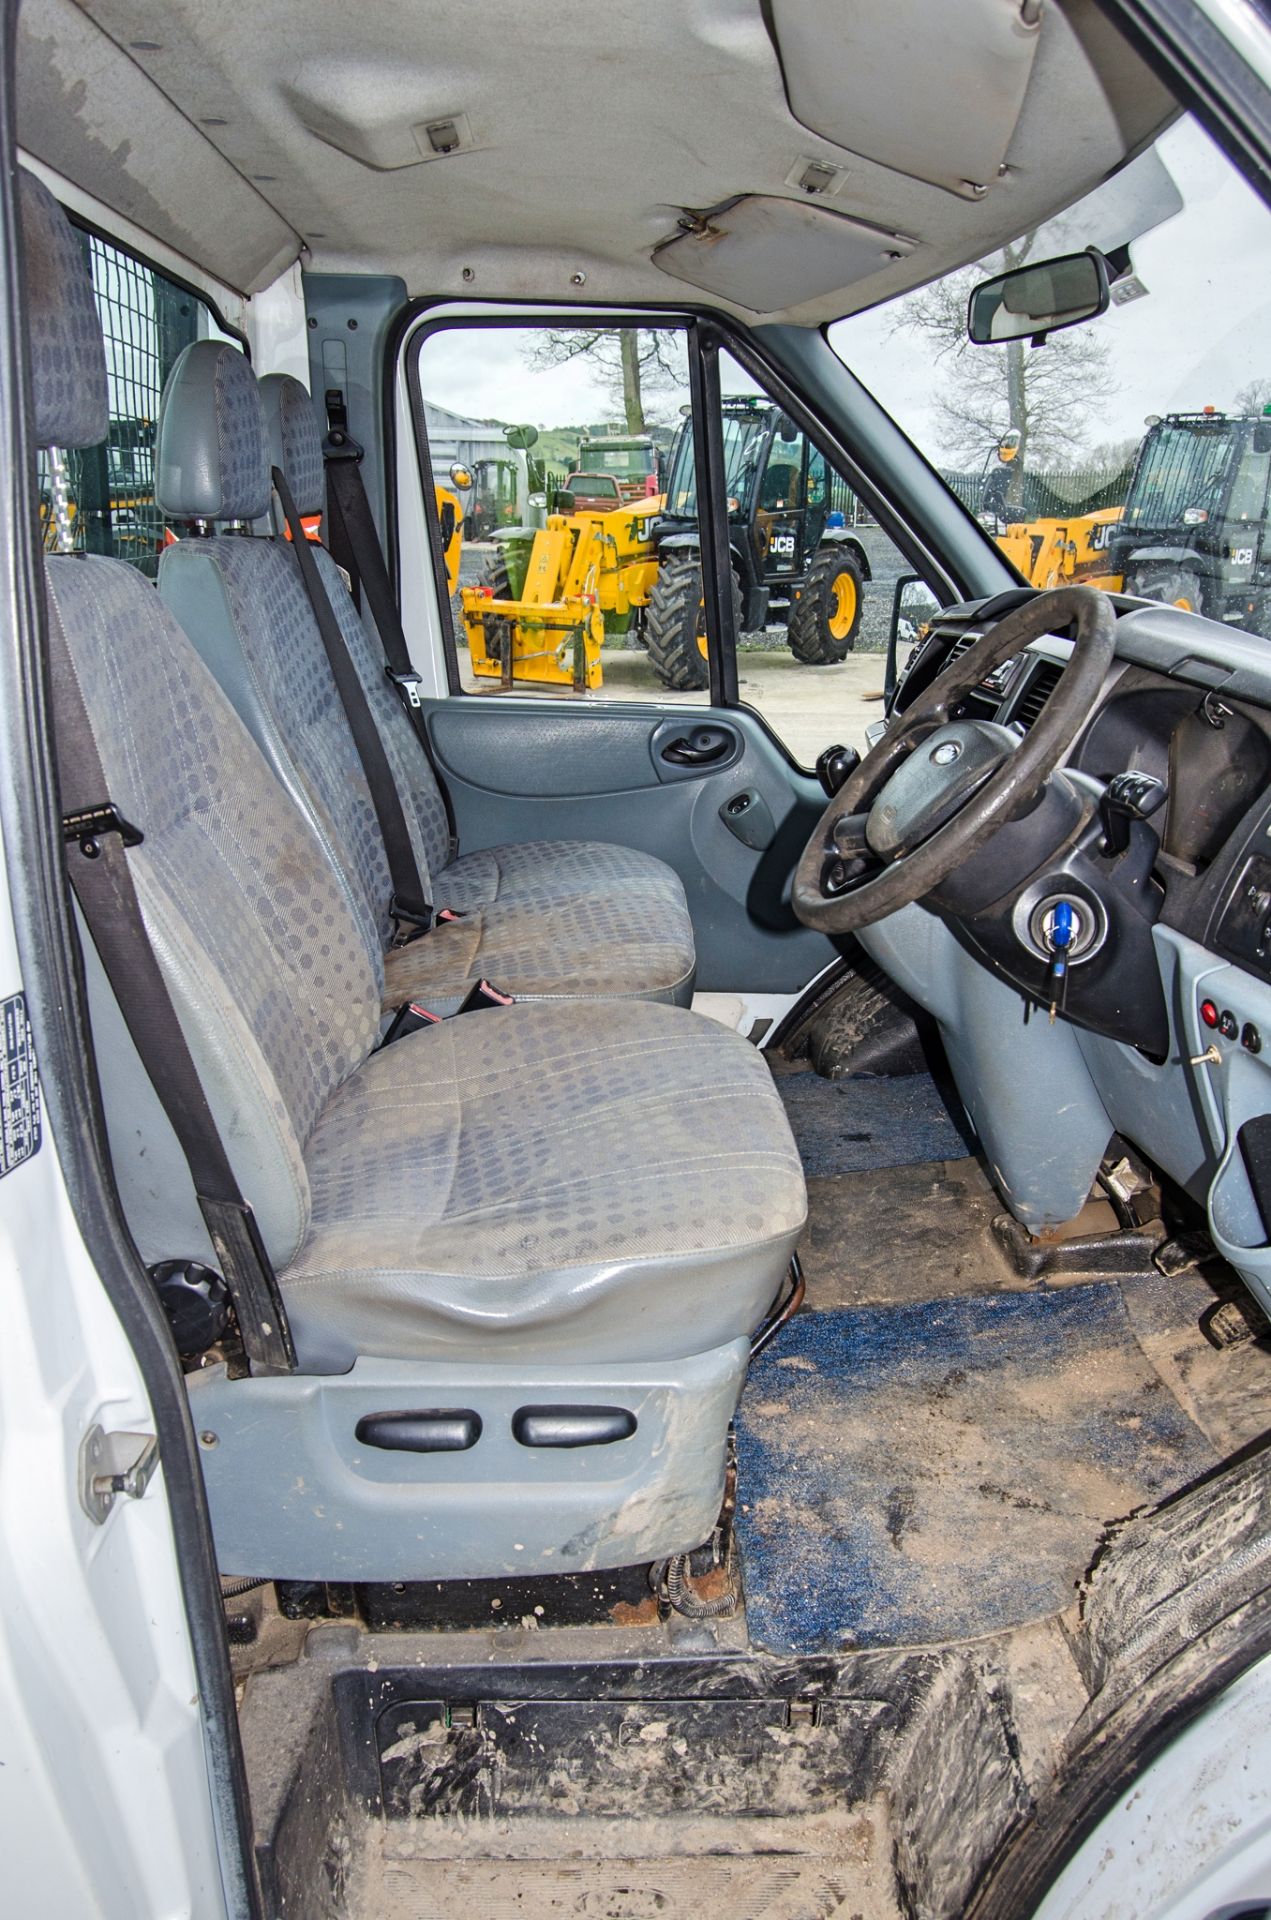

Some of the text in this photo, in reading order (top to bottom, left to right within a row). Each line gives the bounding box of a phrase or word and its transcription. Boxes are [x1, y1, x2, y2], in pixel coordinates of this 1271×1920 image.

[637, 516, 664, 542] JC
[1094, 525, 1118, 550] JC
[769, 536, 795, 553] JCB
[1231, 548, 1253, 565] JCB
